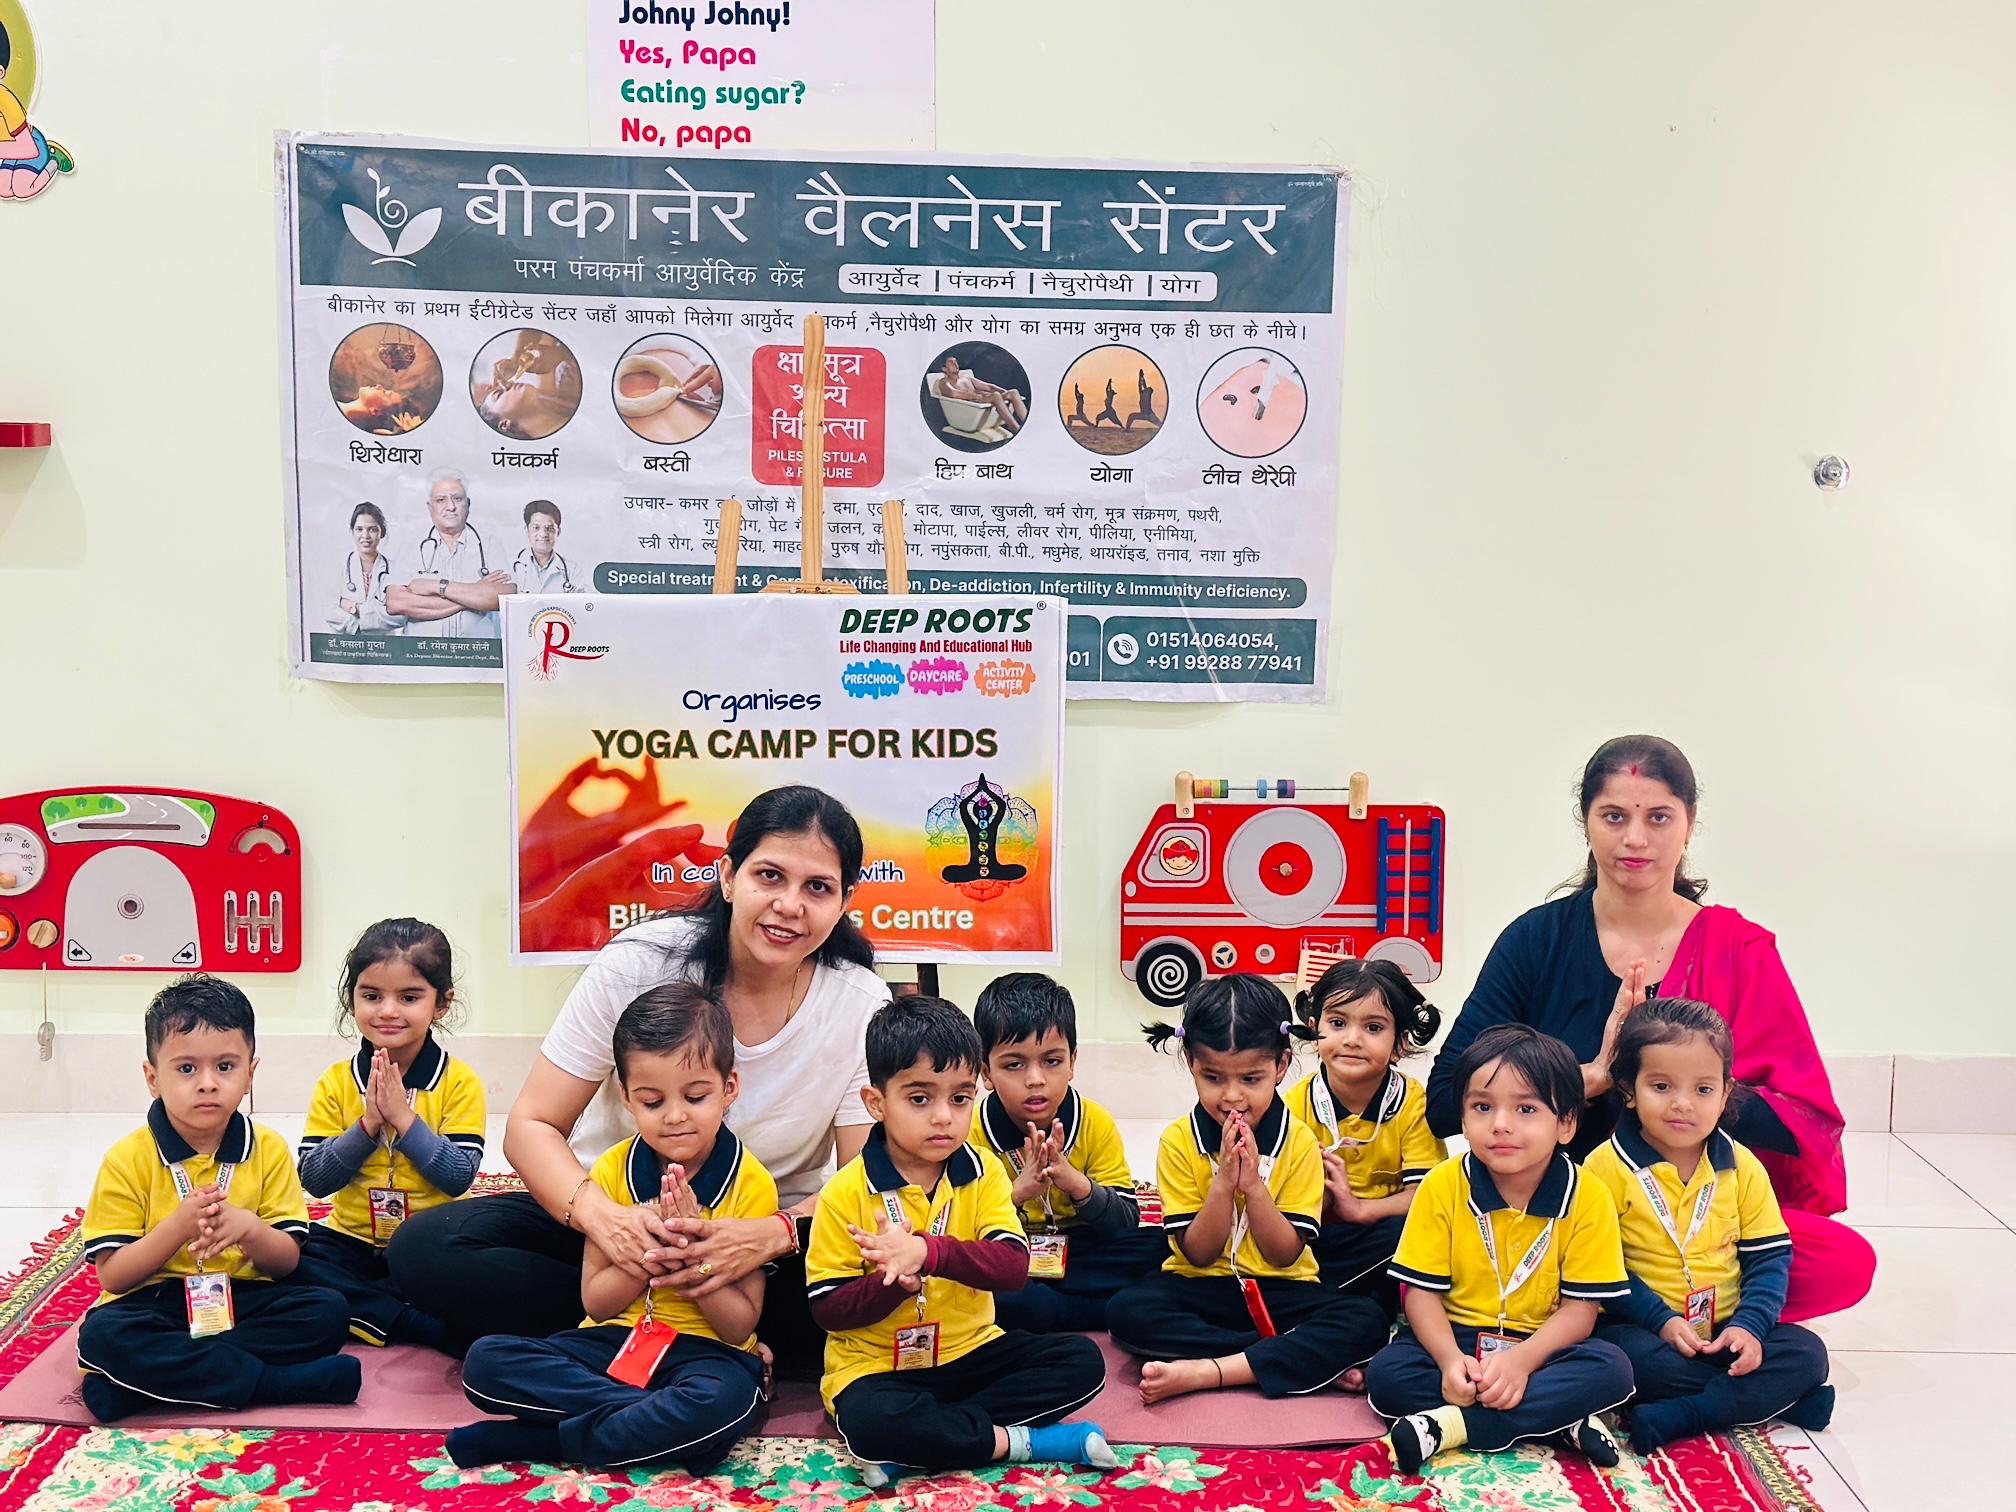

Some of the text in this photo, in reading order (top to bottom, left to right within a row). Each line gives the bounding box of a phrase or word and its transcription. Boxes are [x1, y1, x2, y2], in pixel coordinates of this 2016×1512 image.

[619, 0, 791, 31] Johny Johny!
[619, 39, 756, 71] Yes, Papa
[621, 79, 806, 110] Eating sugar?
[621, 118, 751, 149] No, papa
[457, 163, 1286, 256] बीकानेर वैलनेस सेंटर
[513, 255, 806, 291] परम पंचकर्मा आयुर्वेदिक केंद्र
[848, 267, 1200, 297] आयुर्वेद पंचकर्म नैचुरोपैथी योग
[327, 293, 385, 314] बीकानेर
[394, 300, 416, 315] का
[424, 301, 460, 317] प्रथम
[469, 298, 534, 320] ईंटीग्रेटेड
[541, 302, 577, 321] सेंटर
[586, 303, 617, 323] जहाँ
[625, 305, 676, 325] आपको
[684, 306, 733, 327] मिलेगा
[741, 308, 795, 333] आयुर्वेद
[945, 312, 973, 334] और
[981, 313, 1011, 334] योग
[1020, 320, 1041, 334] का
[1049, 321, 1085, 336] समग्र
[1094, 322, 1141, 341] अनुभव
[1150, 323, 1175, 339] एक
[1184, 319, 1200, 338] ही
[1209, 323, 1234, 339] छत
[1243, 319, 1258, 338] के
[777, 351, 864, 385] क्षासूत्र
[349, 440, 422, 465] शिरोधारा
[492, 447, 559, 470] पंचकर्म
[643, 450, 691, 473] बस्ती
[819, 451, 867, 464] STULA
[785, 466, 794, 478] &
[975, 463, 1013, 480] बाथ
[1090, 461, 1133, 483] योगा
[1202, 463, 1297, 488] लीच थेरेपी
[679, 496, 709, 511] कमर
[746, 495, 780, 514] जोड़ों
[785, 495, 796, 512] में
[832, 502, 860, 516] दमा,
[915, 504, 942, 517] दाद,
[950, 504, 983, 519] खाज,
[991, 502, 1037, 522] खुजली,
[1045, 502, 1065, 519] चर्म
[1072, 502, 1098, 520] रोग,
[1105, 506, 1125, 523] मूत्र
[1132, 503, 1180, 524] संक्रमण,
[1187, 503, 1223, 524] पथरी,
[767, 515, 788, 532] पेट
[827, 522, 865, 536] जलन,
[913, 518, 957, 538] मोटापा,
[964, 521, 1009, 541] पाईल्स,
[1017, 520, 1049, 539] लीवर
[1056, 520, 1082, 541] रोग,
[1089, 521, 1136, 543] पीलिया,
[1144, 523, 1197, 544] एनीमिया,
[638, 535, 661, 550] स्त्री
[668, 535, 694, 552] रोग,
[830, 542, 861, 558] पुरुष
[930, 541, 992, 563] नपुंसकता,
[1042, 541, 1082, 563] मधुमेह,
[1089, 541, 1149, 564] थायरॉइड,
[1156, 547, 1192, 563] तनाव,
[1200, 549, 1226, 563] नशा
[1233, 546, 1261, 564] मुक्ति
[607, 570, 666, 588] Special
[754, 573, 762, 587] &
[930, 577, 1037, 596] De-addiction,
[1040, 579, 1111, 597] Infertility
[1115, 582, 1127, 595] &
[1130, 581, 1203, 599] Immunity
[1206, 582, 1292, 602] deficiency.
[839, 608, 919, 634] DEEP
[924, 608, 1033, 633] ROOTS
[569, 645, 610, 653] DEEP ROOTS
[839, 639, 1032, 654] Life Changing And Educational Hub
[1146, 631, 1280, 652] 01514064054,
[982, 666, 1026, 678] ACTIVITY
[1146, 654, 1302, 672] +91 99288 77941
[844, 674, 900, 685] PRESCHOOL
[909, 669, 963, 683] DAYCARE
[985, 679, 1023, 691] CENTER
[682, 689, 822, 722] Organises
[592, 728, 999, 760] YOGA CAMP FOR KIDS
[653, 862, 674, 882] In
[871, 903, 974, 930] Centre
[174, 1170, 188, 1194] ROOTS
[1642, 1177, 1658, 1200] ROOTS
[886, 1198, 900, 1223] ROOTS
[1523, 1249, 1535, 1267] DEEP
[1533, 1230, 1550, 1252] ROOTS
